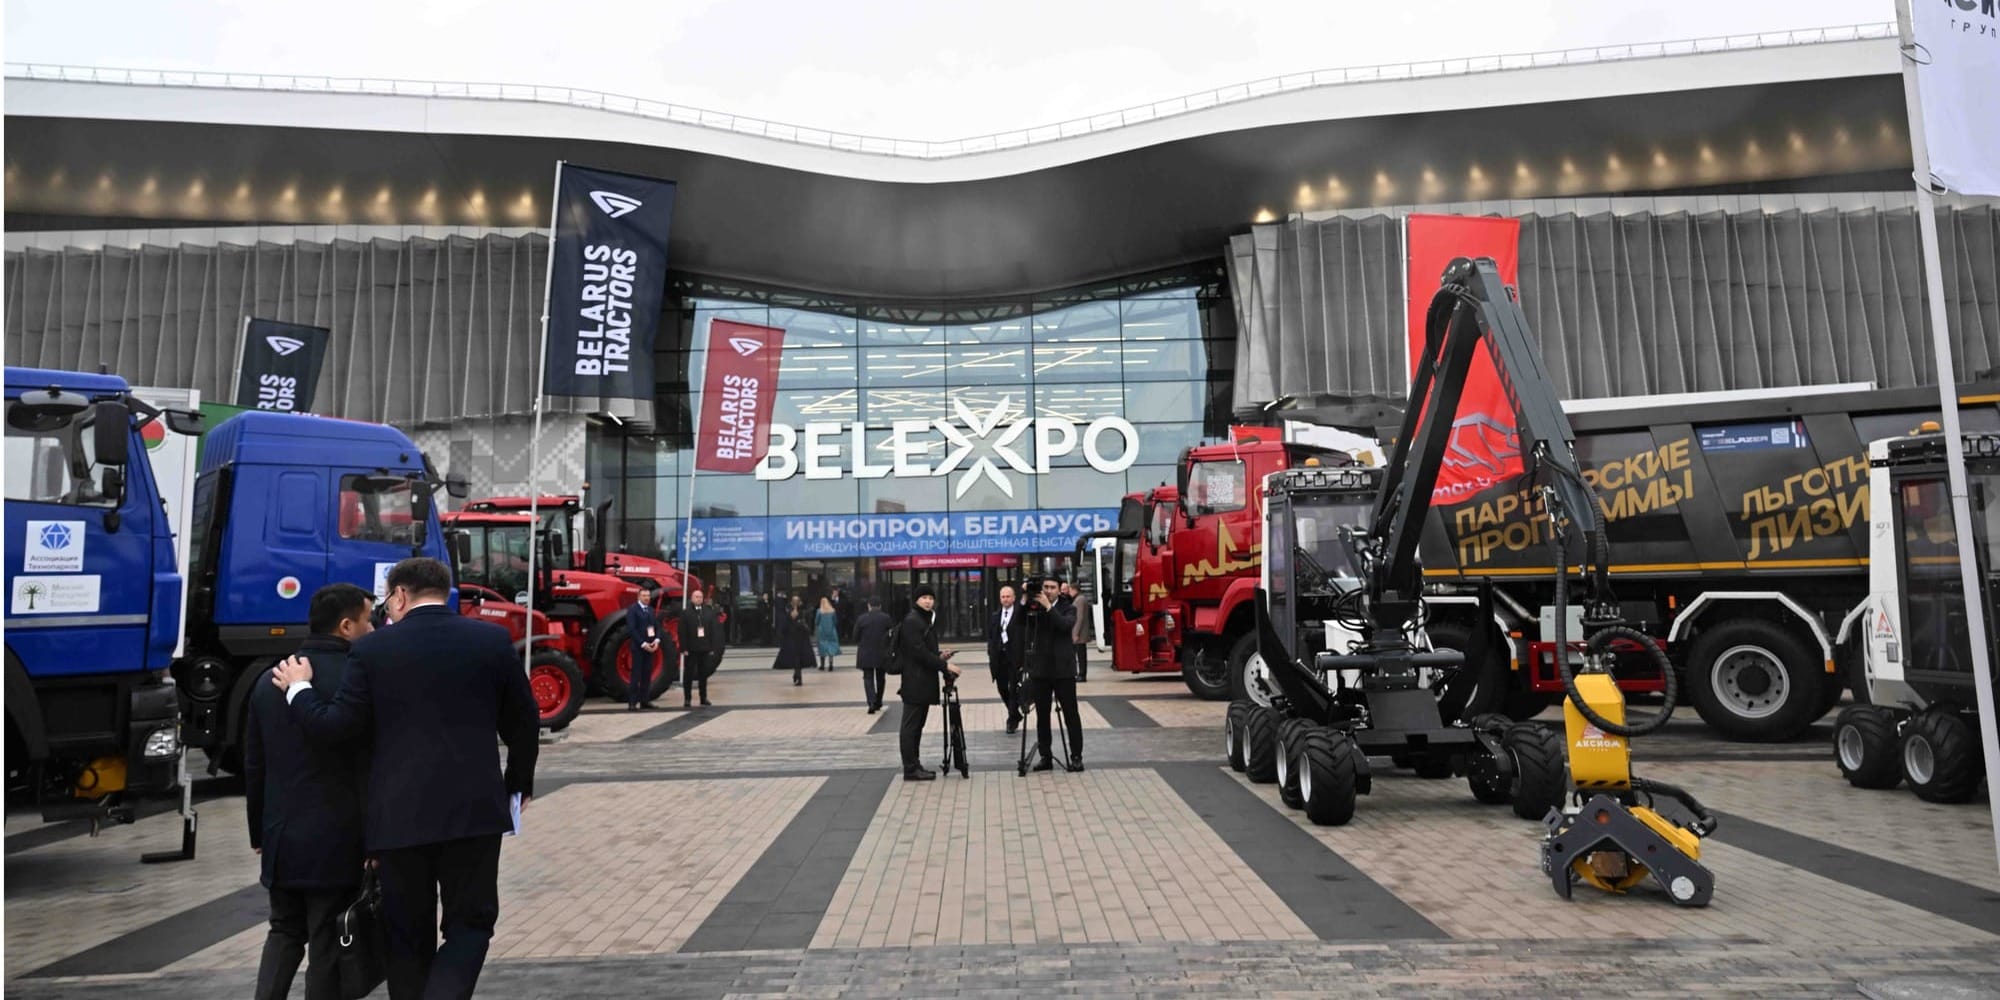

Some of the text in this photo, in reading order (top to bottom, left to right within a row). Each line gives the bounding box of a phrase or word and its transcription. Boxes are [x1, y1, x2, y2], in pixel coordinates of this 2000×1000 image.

[575, 244, 612, 376] BELARUS
[602, 248, 638, 376] TRACTORS
[257, 374, 280, 410] RUS
[276, 376, 297, 410] ORS
[716, 374, 741, 460] BELARUS
[735, 377, 759, 460] TRACTORS
[755, 395, 1140, 499] BELEXPO
[1740, 450, 1870, 520] ЛЬГОТН
[1747, 483, 1870, 561] ЛИЗИ
[786, 513, 1111, 540] ИННОПРОМ. БЕЛАРУСЬ
[804, 540, 917, 553] МЕЖДУНАРОДНАЯ
[920, 537, 1029, 550] ПРОМЫШЛЕННАЯ
[480, 608, 507, 617] BELARUS
